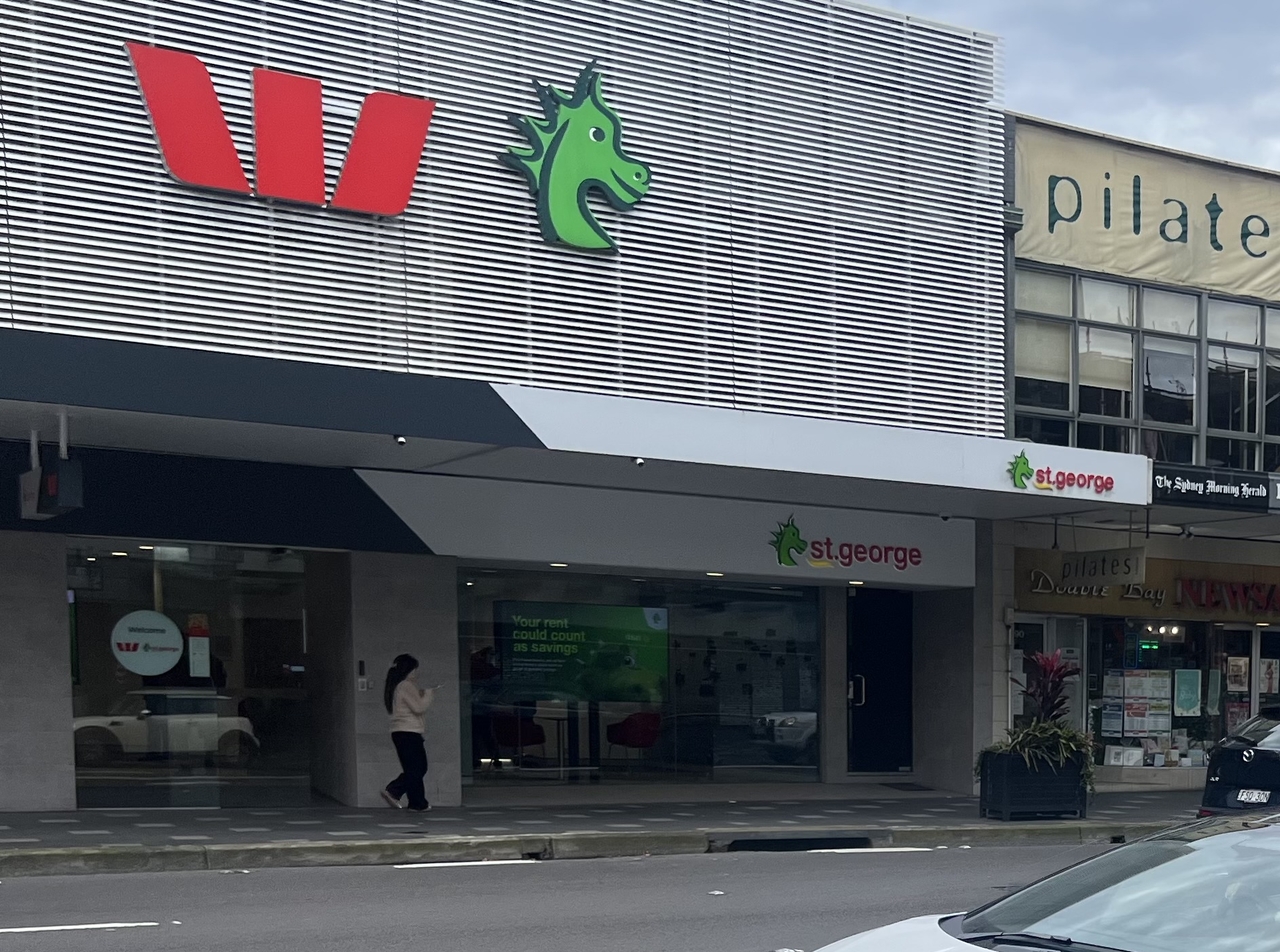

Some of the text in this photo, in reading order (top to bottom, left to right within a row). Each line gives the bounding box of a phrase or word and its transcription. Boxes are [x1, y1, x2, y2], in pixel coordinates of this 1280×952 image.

[1035, 467, 1114, 494] st.george
[1155, 475, 1267, 498] The Sydney Morning Herald
[810, 537, 923, 571] st.george
[1062, 557, 1131, 582] pilates
[1123, 583, 1167, 607] Bay
[512, 615, 569, 629] Your rent
[513, 629, 585, 642] could count
[513, 642, 579, 656] as savings
